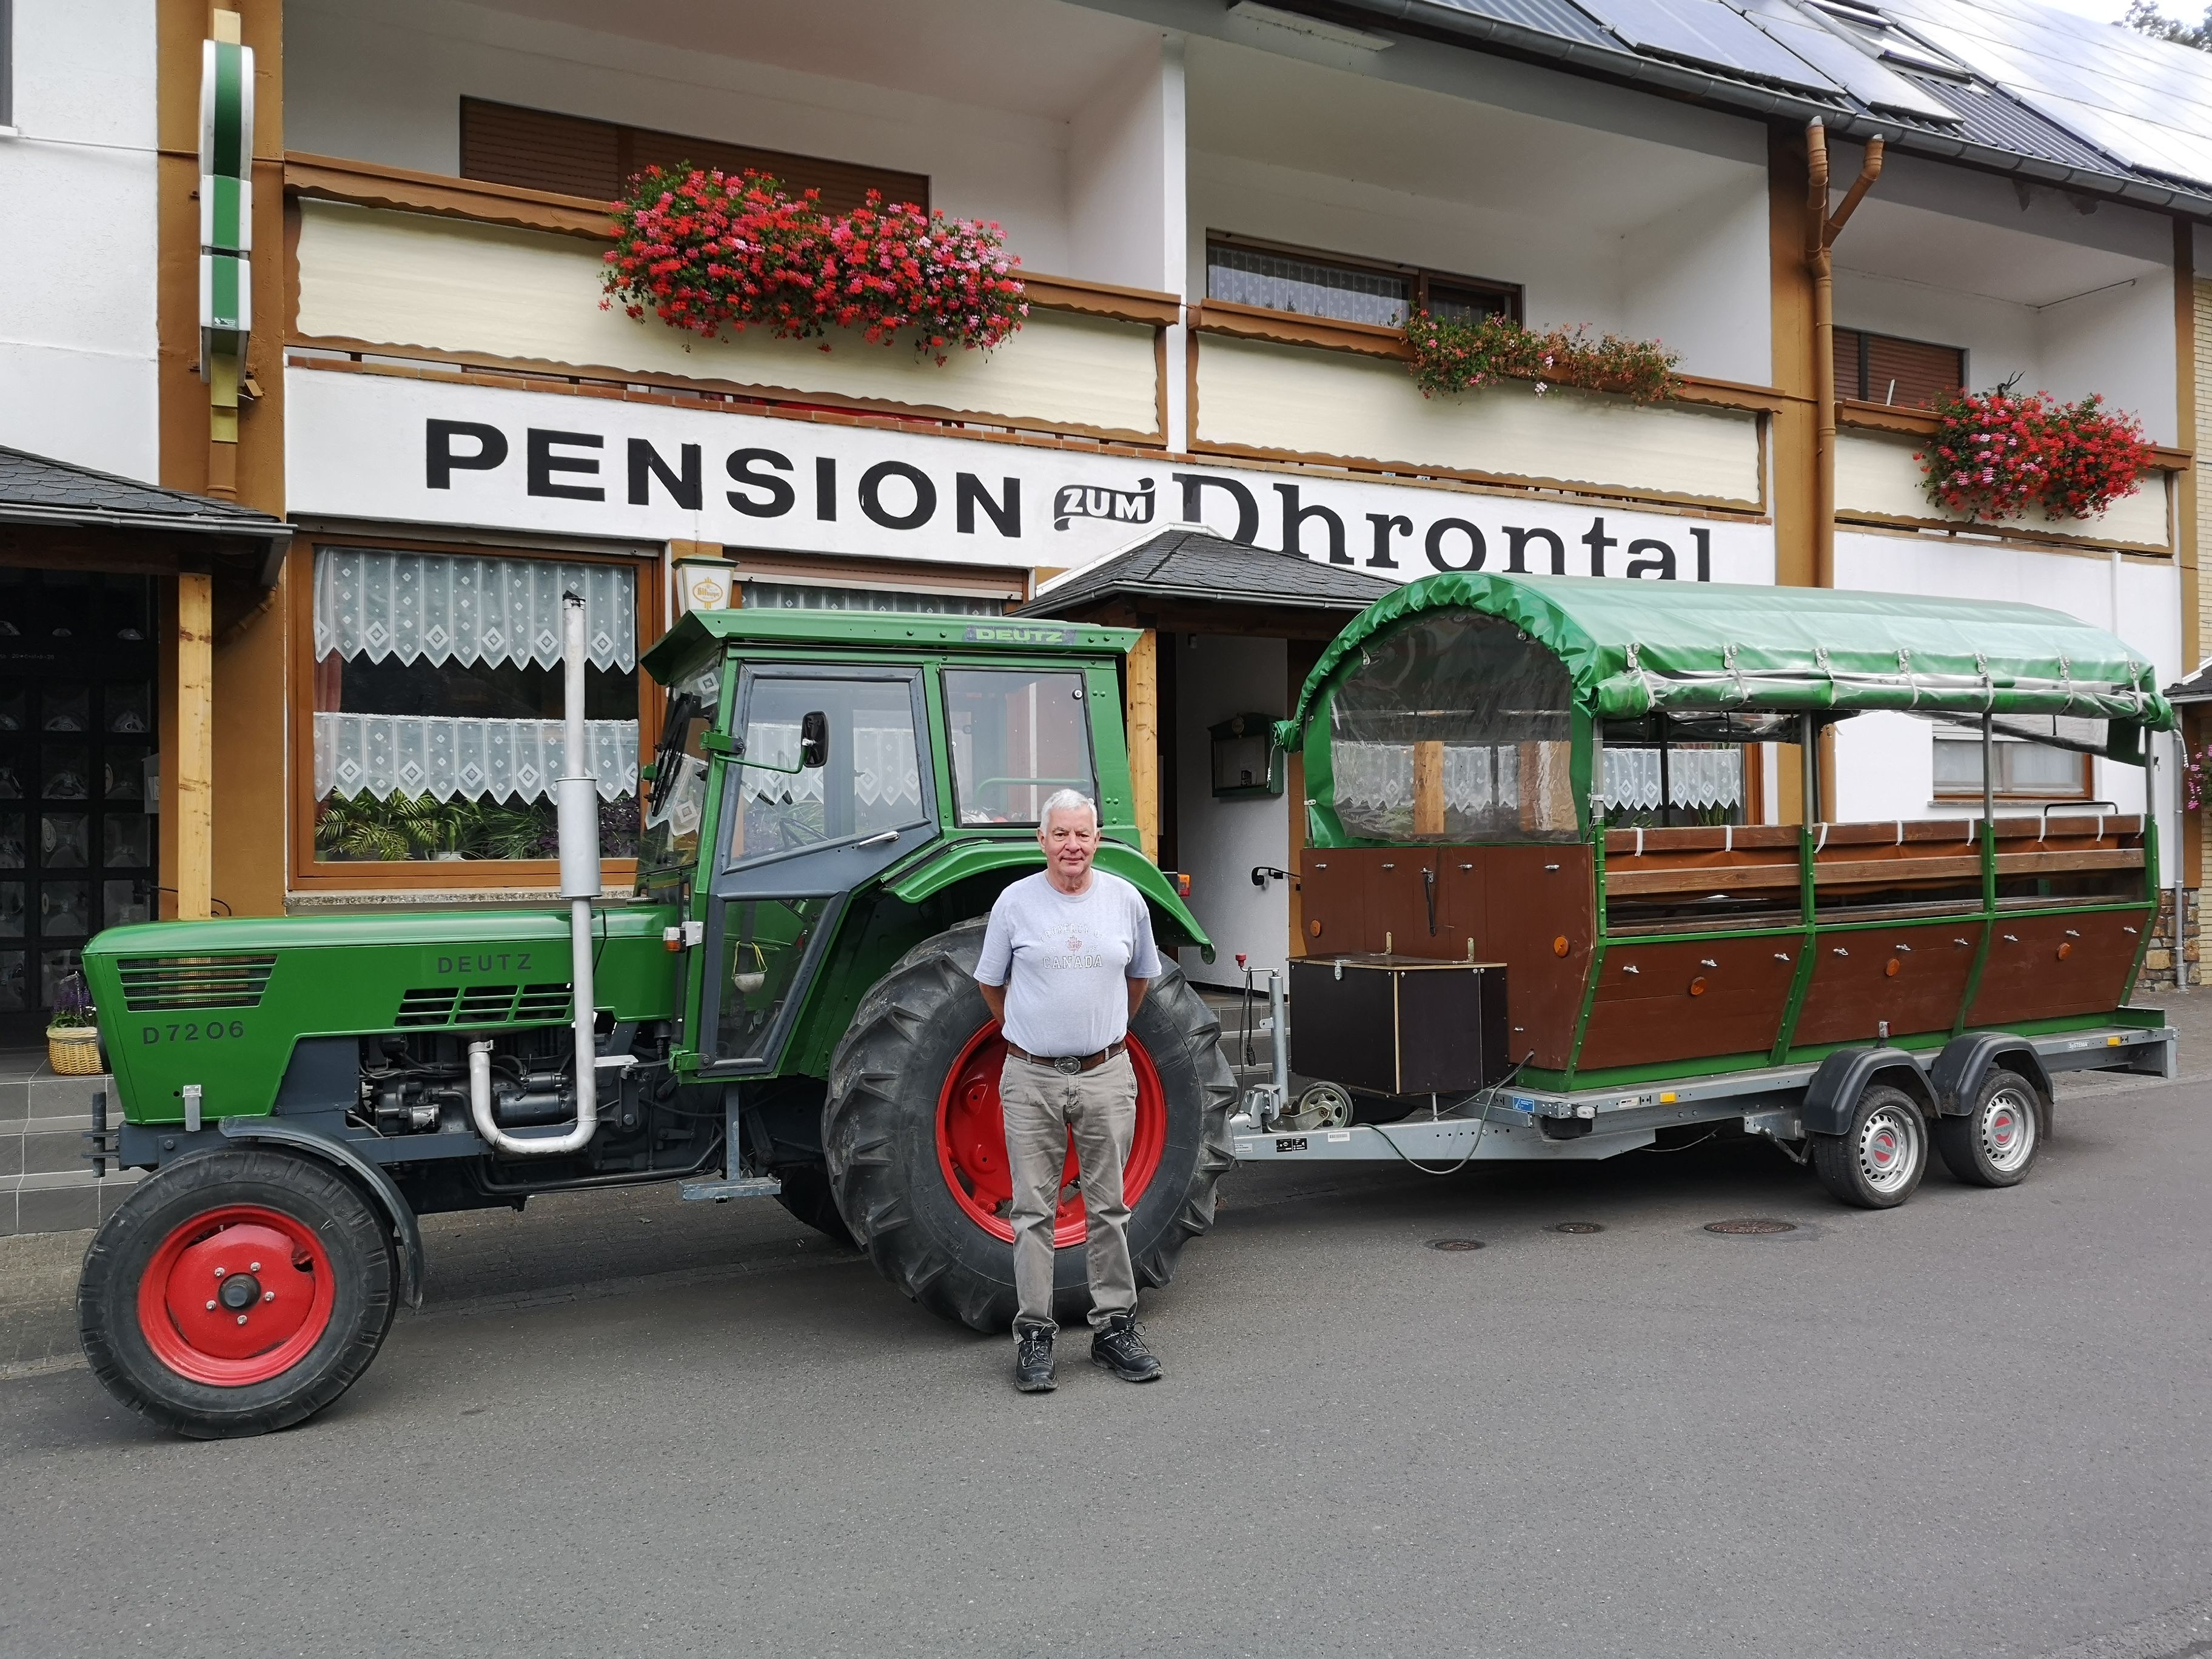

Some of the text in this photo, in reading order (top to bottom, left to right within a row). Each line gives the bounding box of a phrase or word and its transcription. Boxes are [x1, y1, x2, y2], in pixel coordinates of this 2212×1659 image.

[426, 418, 1710, 583] PENSION ZUM Dhrontal
[976, 628, 1063, 642] DEUTZ
[1038, 923, 1090, 944] PROPERTY
[438, 953, 532, 974] DEUTZ
[1042, 954, 1103, 969] CANADA
[143, 1021, 244, 1045] D7206
